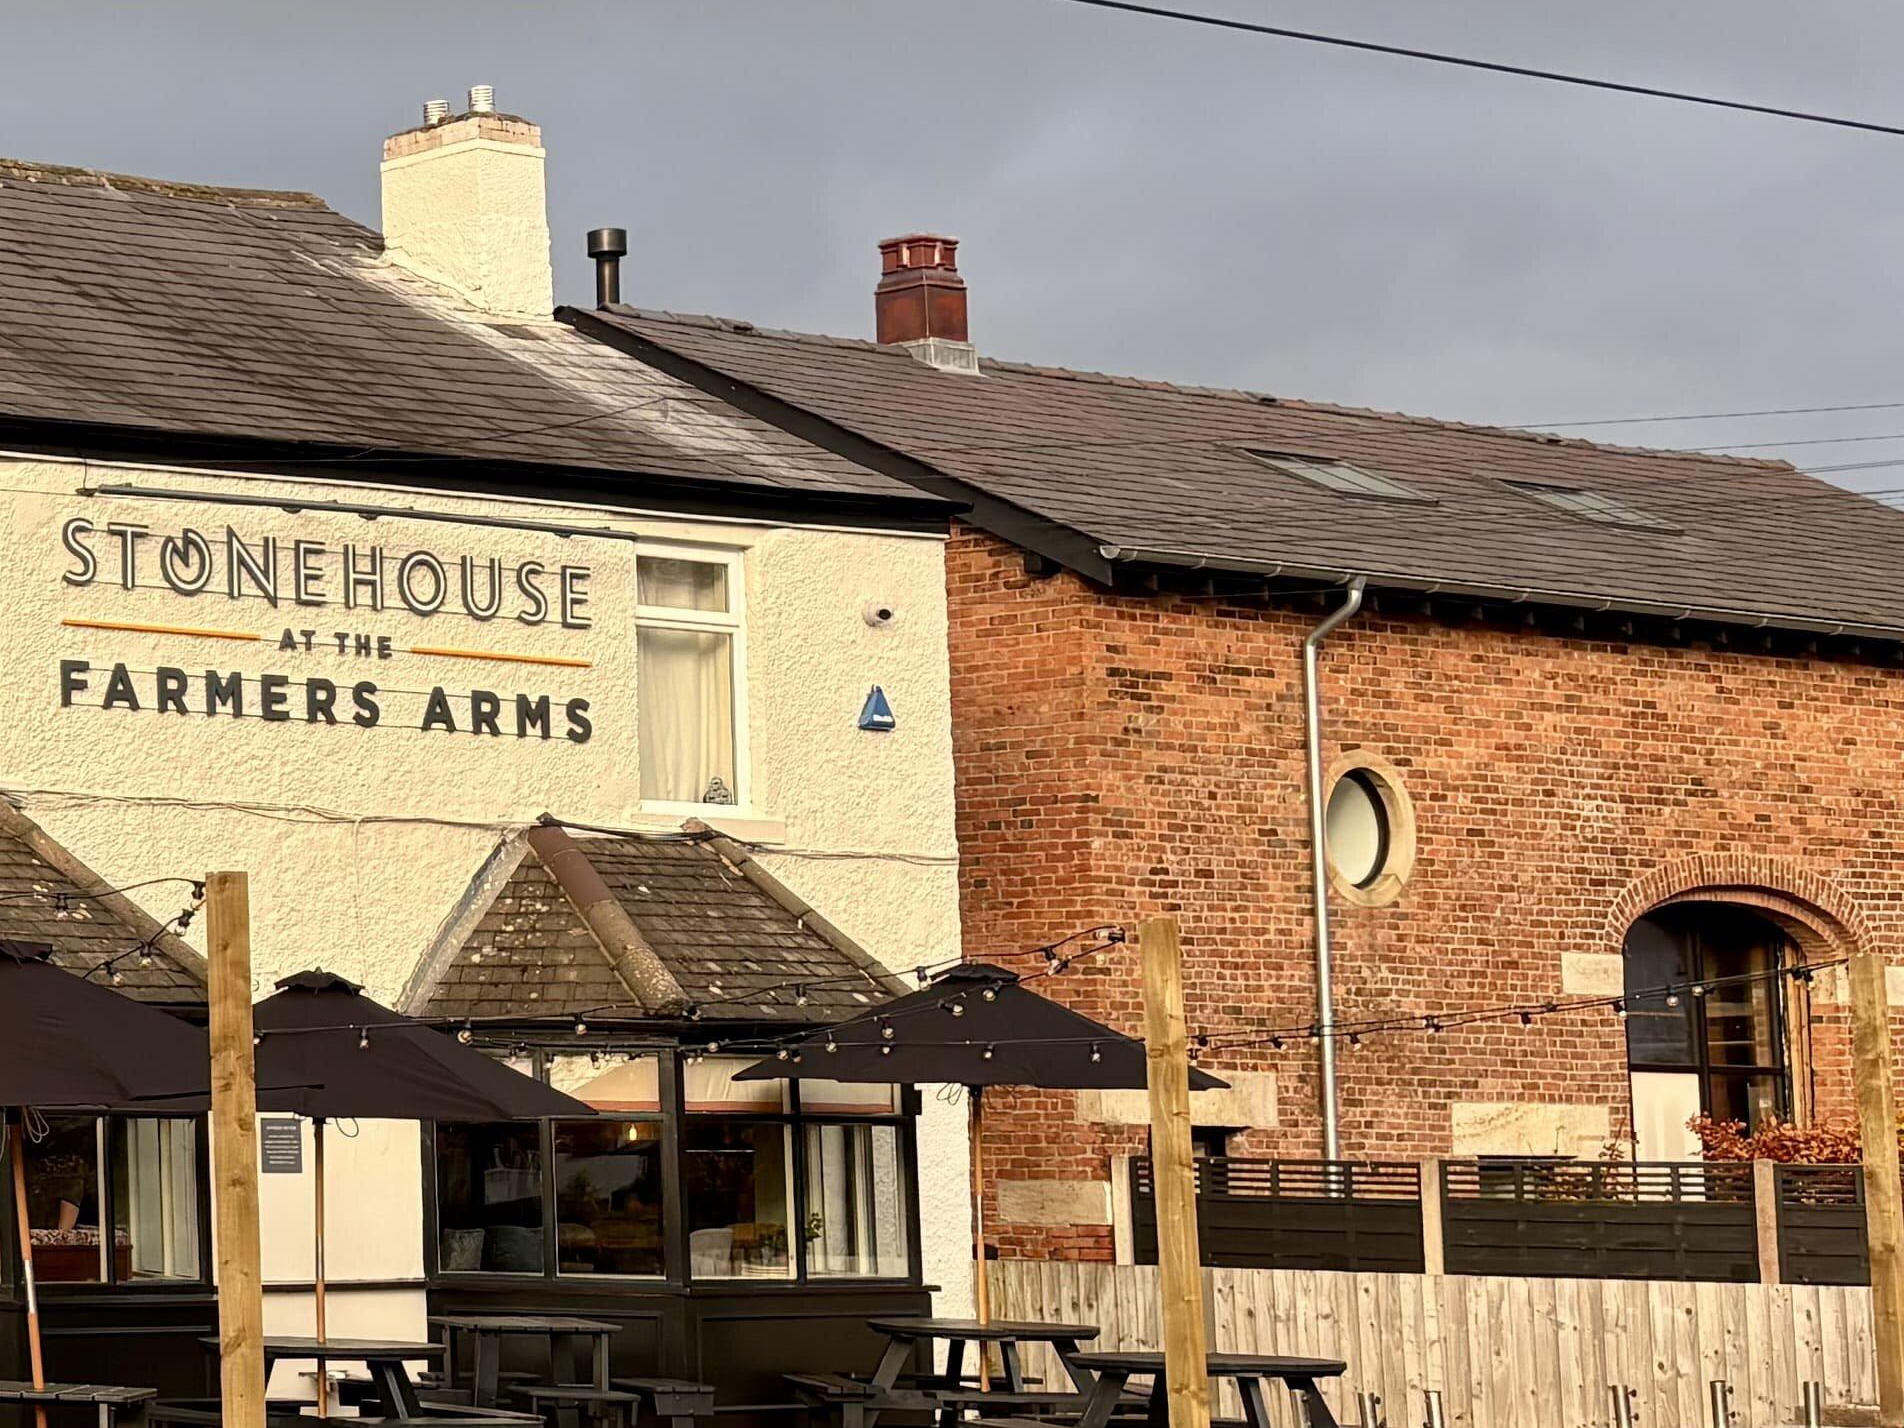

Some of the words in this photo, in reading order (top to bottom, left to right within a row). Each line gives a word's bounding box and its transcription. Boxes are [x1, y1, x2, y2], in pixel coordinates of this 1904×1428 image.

[62, 517, 592, 629] STONEHOUSE
[278, 627, 317, 651] AT
[333, 632, 392, 660] THE
[59, 659, 380, 727] FARMERS
[421, 686, 593, 743] ARMS
